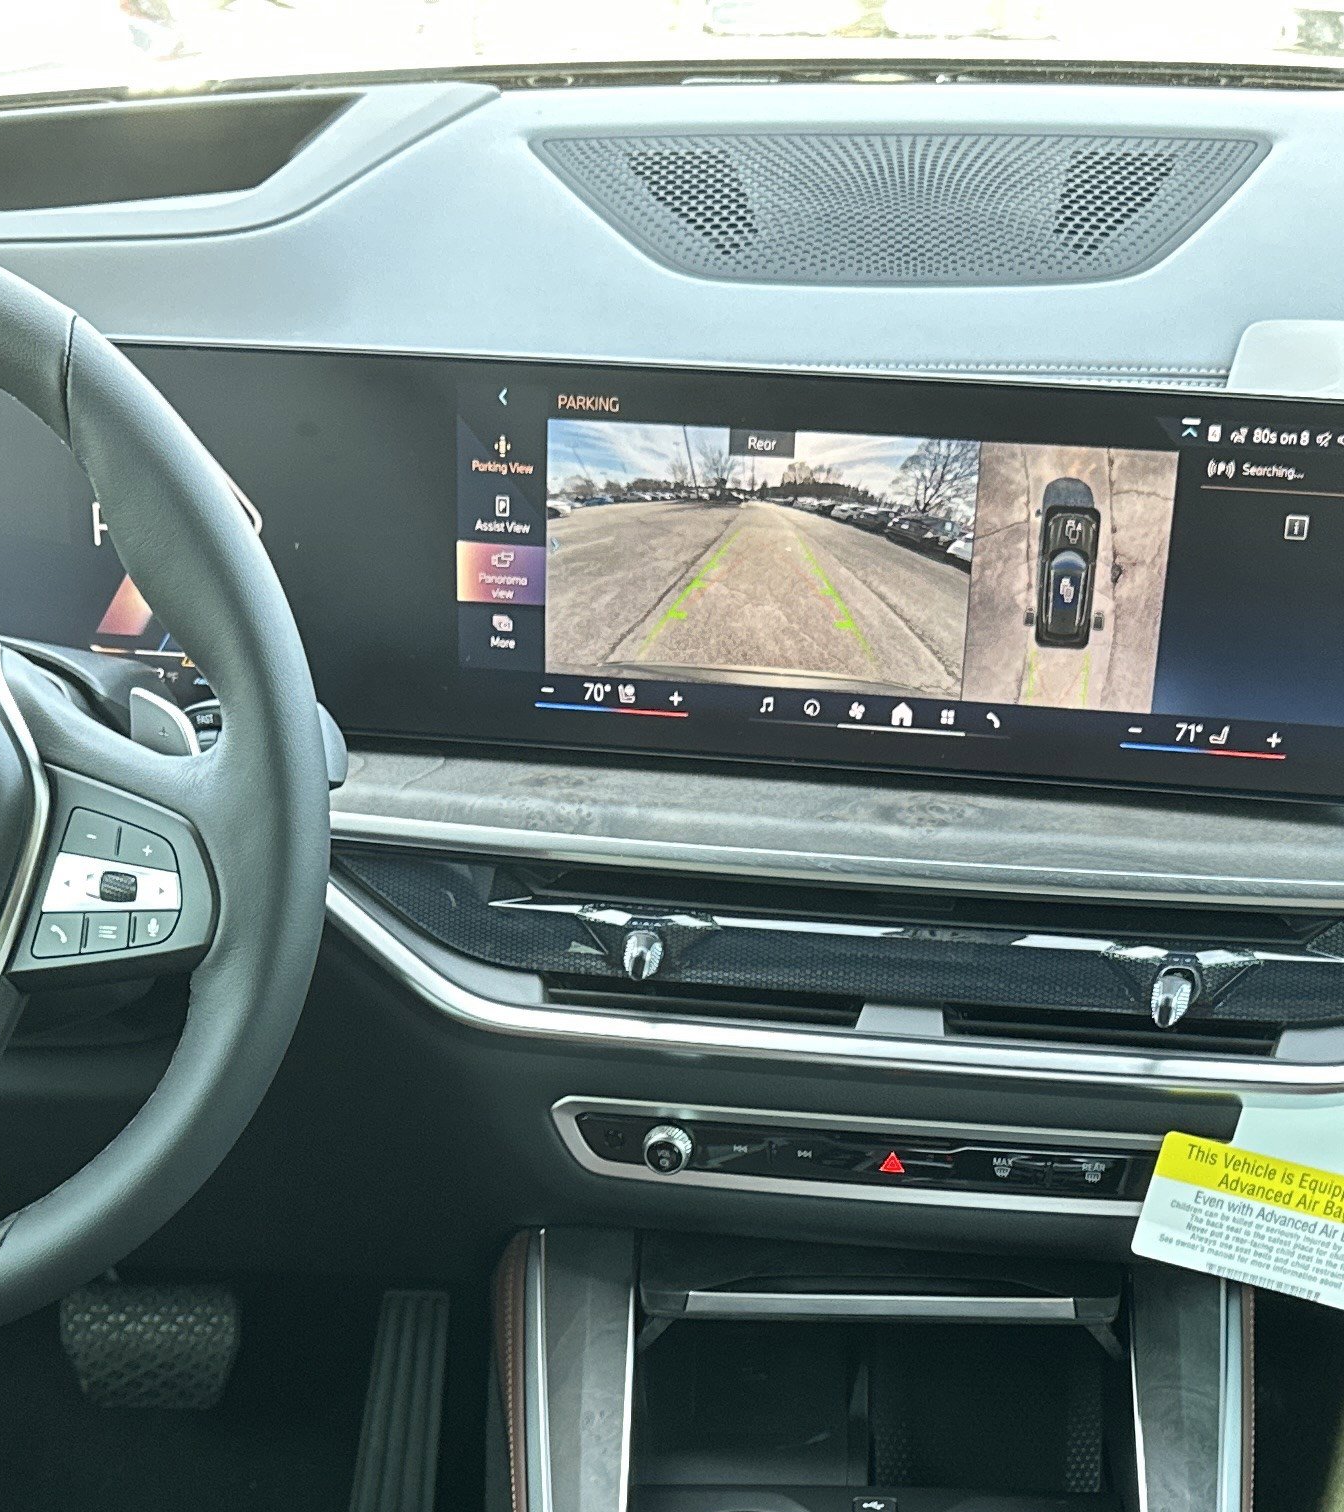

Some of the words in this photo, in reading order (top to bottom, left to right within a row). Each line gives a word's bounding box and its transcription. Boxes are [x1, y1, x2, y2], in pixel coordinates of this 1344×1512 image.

[557, 393, 620, 413] PARKING
[747, 435, 777, 451] Rear
[1252, 427, 1277, 445] 80s
[1279, 431, 1298, 446] on
[1299, 429, 1310, 446] 8
[471, 459, 507, 476] Parking
[508, 462, 534, 475] View
[474, 518, 506, 533] Assist
[506, 521, 531, 534] View
[478, 572, 528, 586] Panorama
[490, 635, 516, 650] More
[992, 1157, 1013, 1167] MAX
[1081, 1162, 1106, 1172] REAR
[1187, 1143, 1218, 1166] This
[1224, 1152, 1277, 1181] Vehicle
[1280, 1167, 1295, 1186] is
[1217, 1173, 1294, 1205] Advanced
[1295, 1193, 1320, 1212] Air
[1194, 1190, 1225, 1210] Even
[1227, 1201, 1254, 1217] with
[1255, 1207, 1318, 1234] Advanced
[1318, 1223, 1339, 1239] Air
